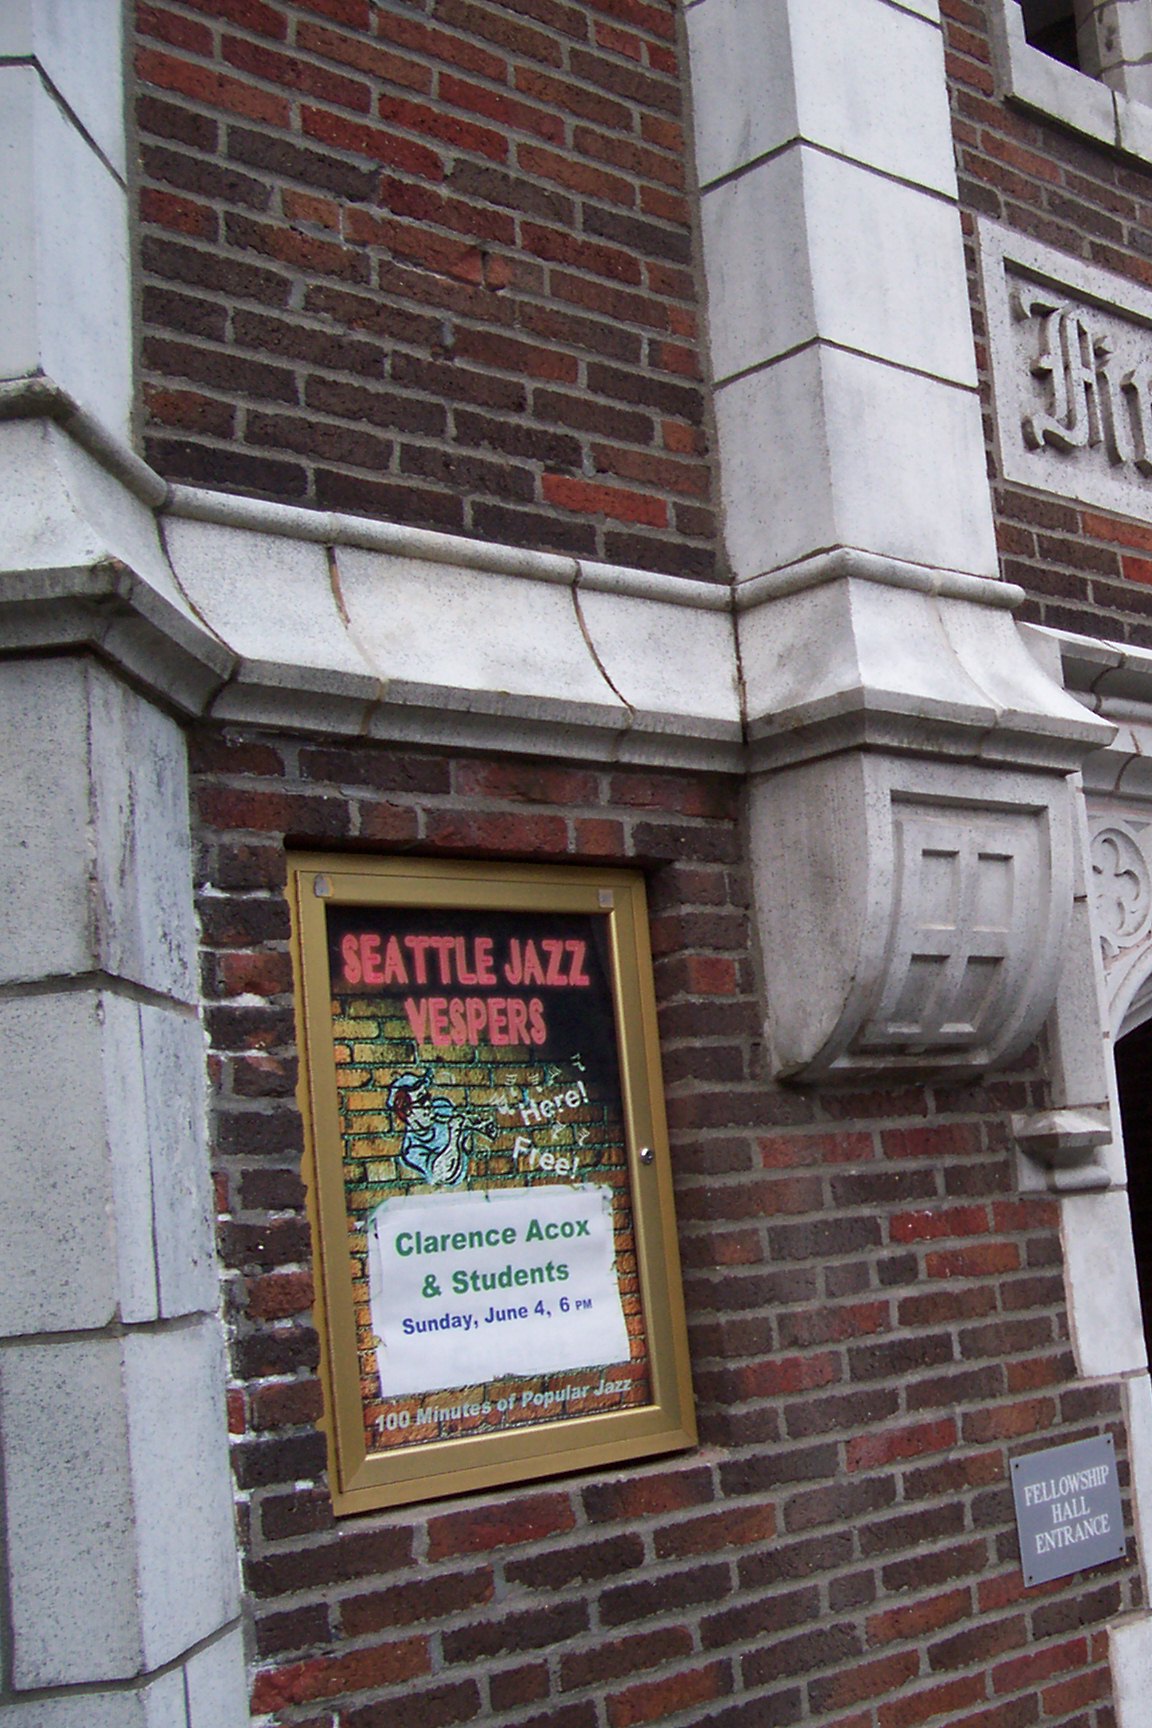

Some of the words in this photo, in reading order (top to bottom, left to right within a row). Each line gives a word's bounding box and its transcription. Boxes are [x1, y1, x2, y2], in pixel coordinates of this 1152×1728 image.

[340, 933, 498, 985] SEATTLE
[504, 937, 590, 986] JAZZ
[404, 998, 547, 1046] VESPERS
[519, 1081, 588, 1126] Here!
[512, 1136, 580, 1179] Free!
[395, 1227, 516, 1257] Clarence
[525, 1218, 591, 1241] Acox
[421, 1274, 442, 1298] &
[452, 1261, 569, 1294] Students
[402, 1313, 480, 1335] Sunday,
[485, 1306, 529, 1324] June
[534, 1303, 552, 1317] 4,
[559, 1297, 571, 1313] 6
[575, 1299, 593, 1311] PM
[375, 1412, 411, 1432] 100
[416, 1402, 491, 1425] Minutes
[496, 1396, 516, 1411] of
[521, 1385, 590, 1409] Popular
[594, 1377, 632, 1396] Jazz
[1025, 1465, 1109, 1506] FELLOWSHIP
[1052, 1496, 1090, 1523] HALL
[1035, 1514, 1110, 1554] ENTRANCE
